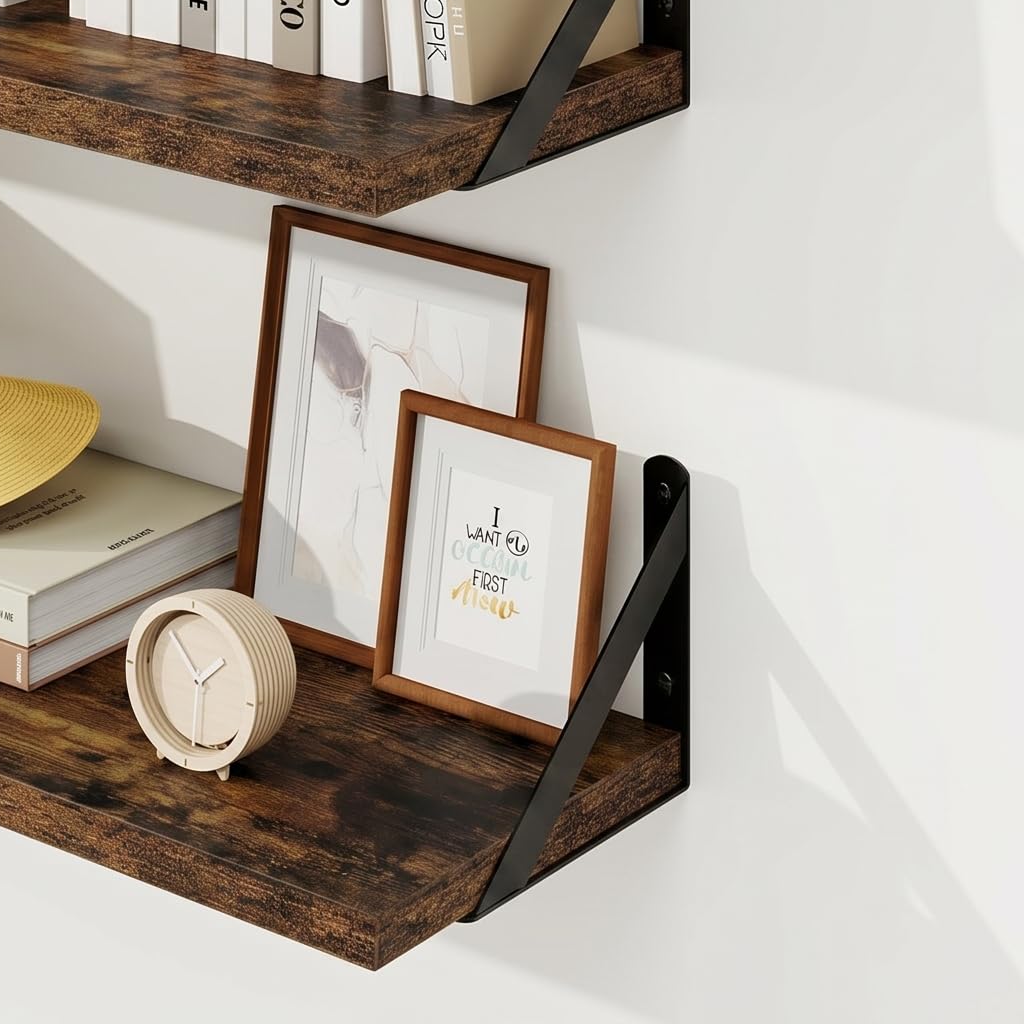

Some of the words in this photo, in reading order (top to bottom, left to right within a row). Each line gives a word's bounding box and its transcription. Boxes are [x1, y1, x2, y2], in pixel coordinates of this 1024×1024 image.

[490, 506, 501, 529] I
[466, 523, 503, 548] WANT
[472, 568, 509, 595] FIRST
